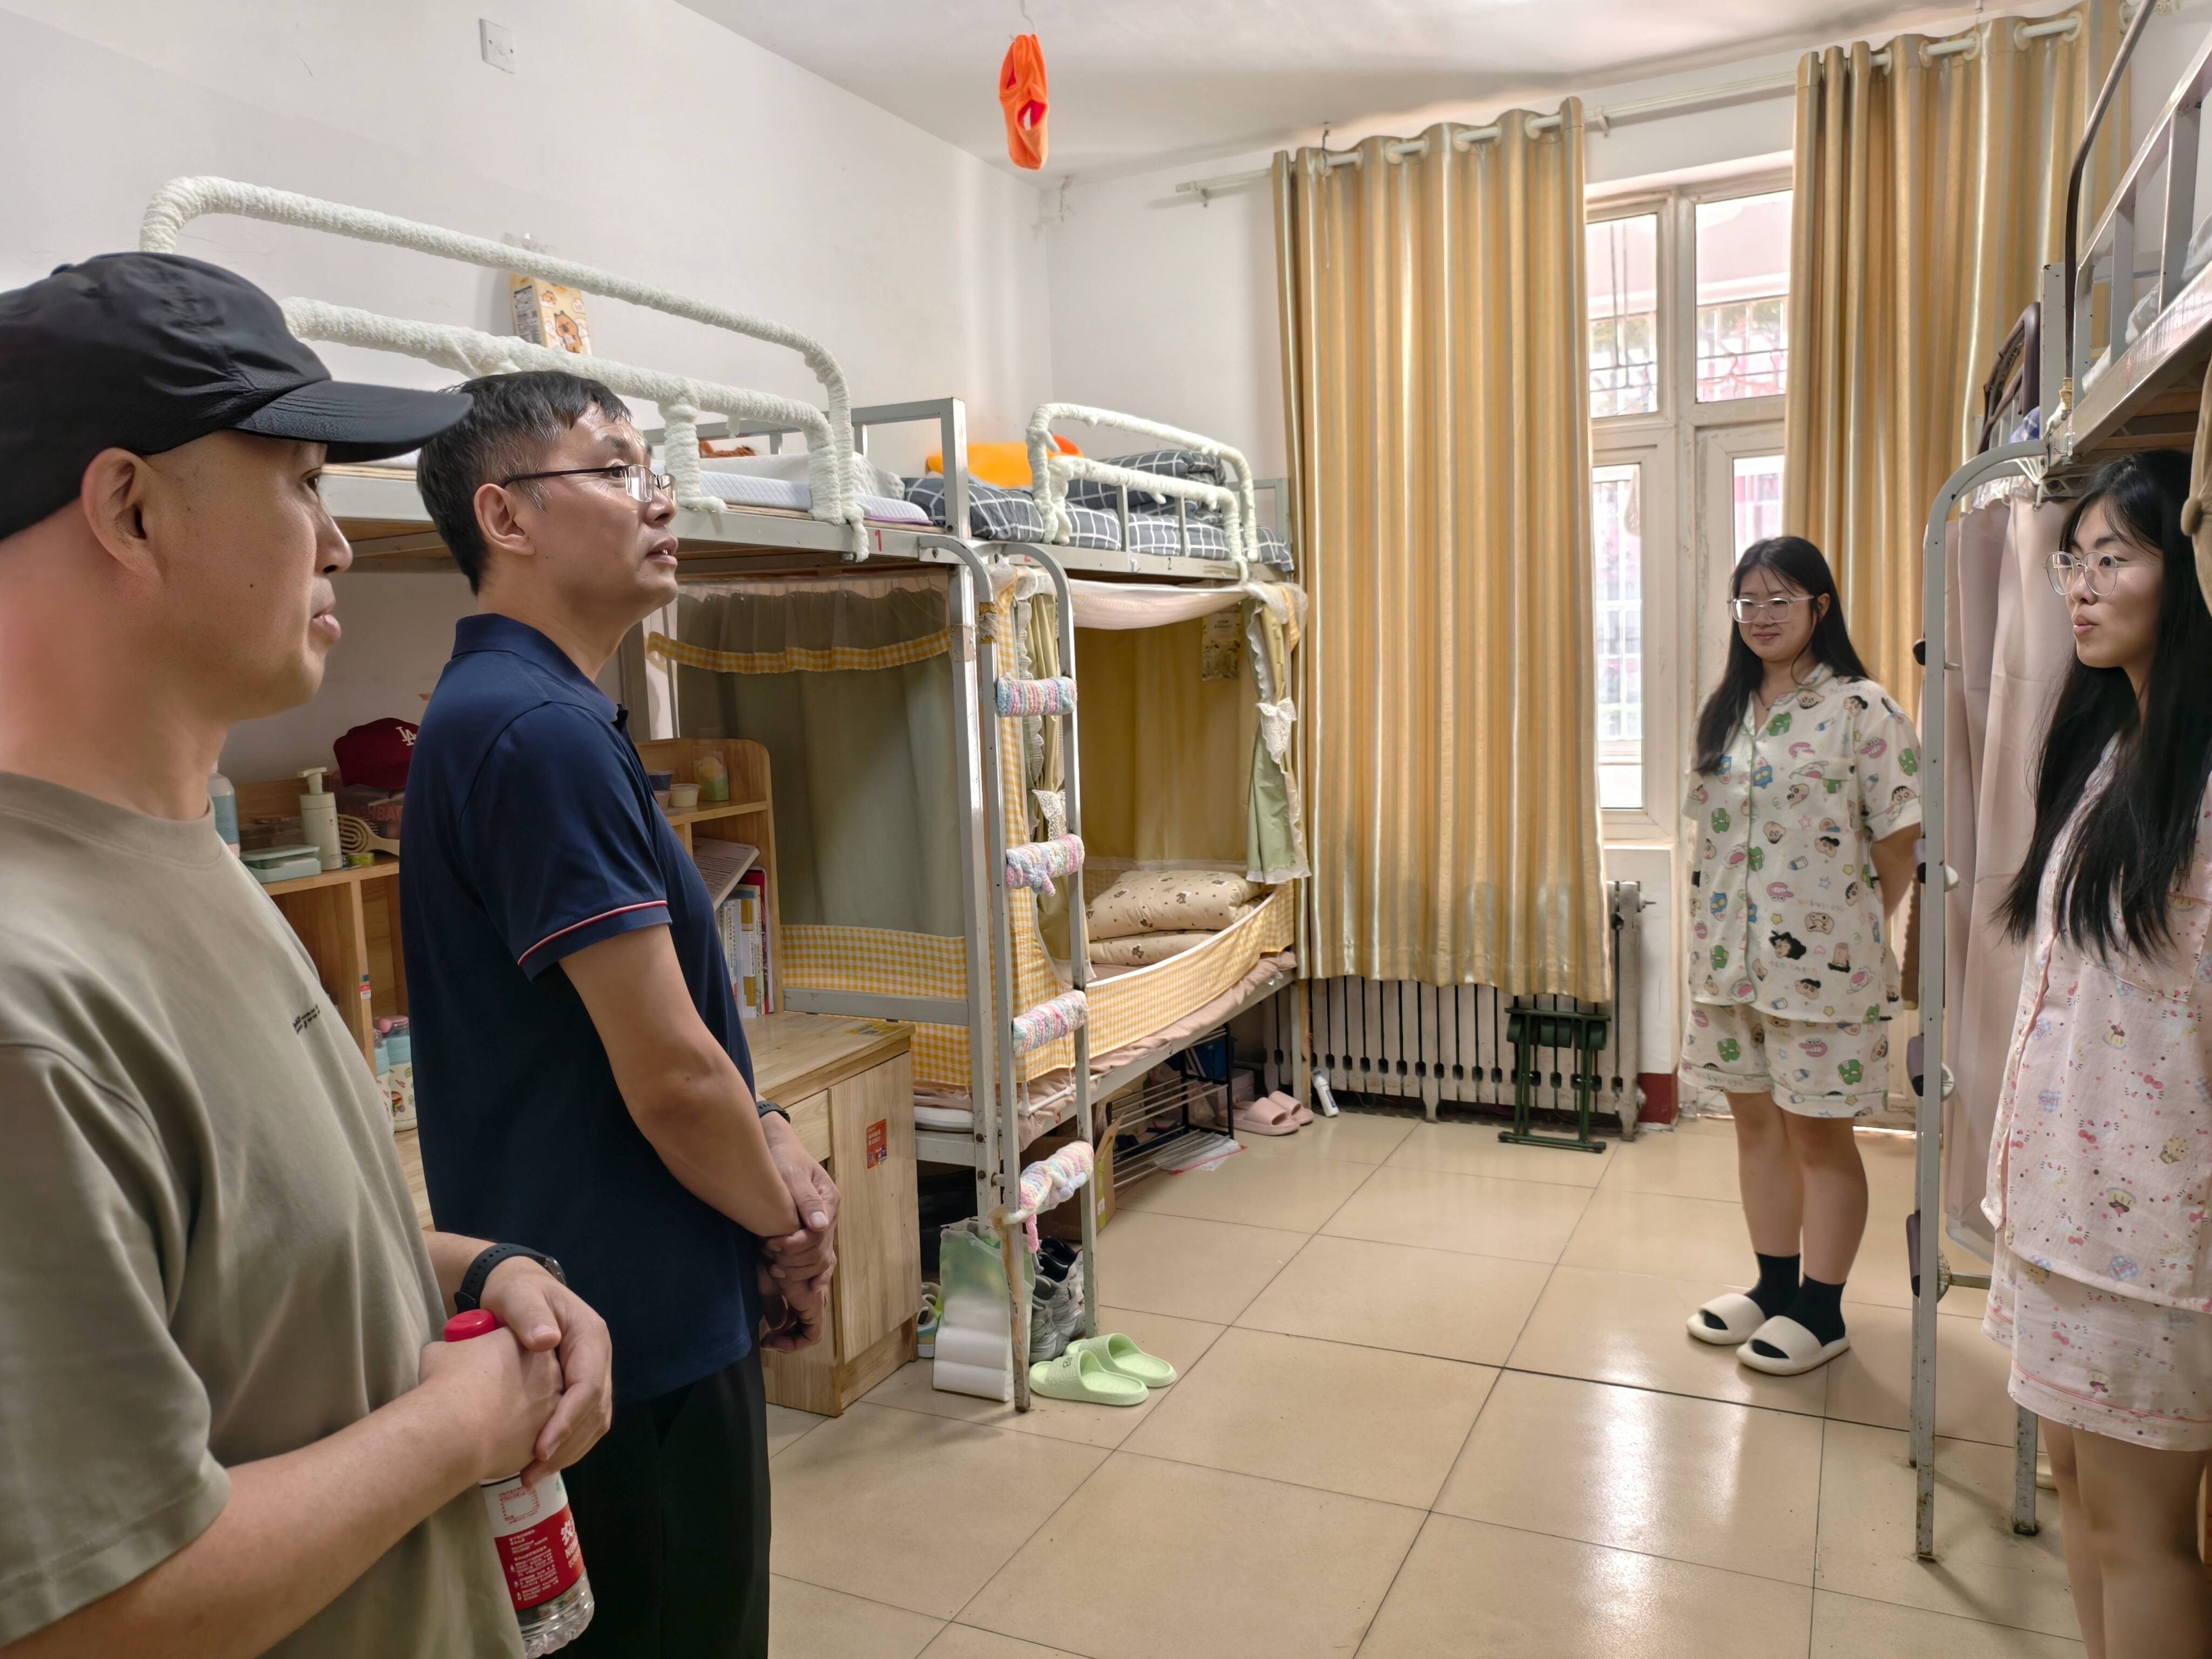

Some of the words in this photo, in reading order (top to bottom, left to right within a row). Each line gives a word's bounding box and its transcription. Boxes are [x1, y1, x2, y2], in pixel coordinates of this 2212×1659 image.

[874, 529, 882, 551] 1
[1167, 557, 1172, 571] 2
[396, 726, 417, 746] LA
